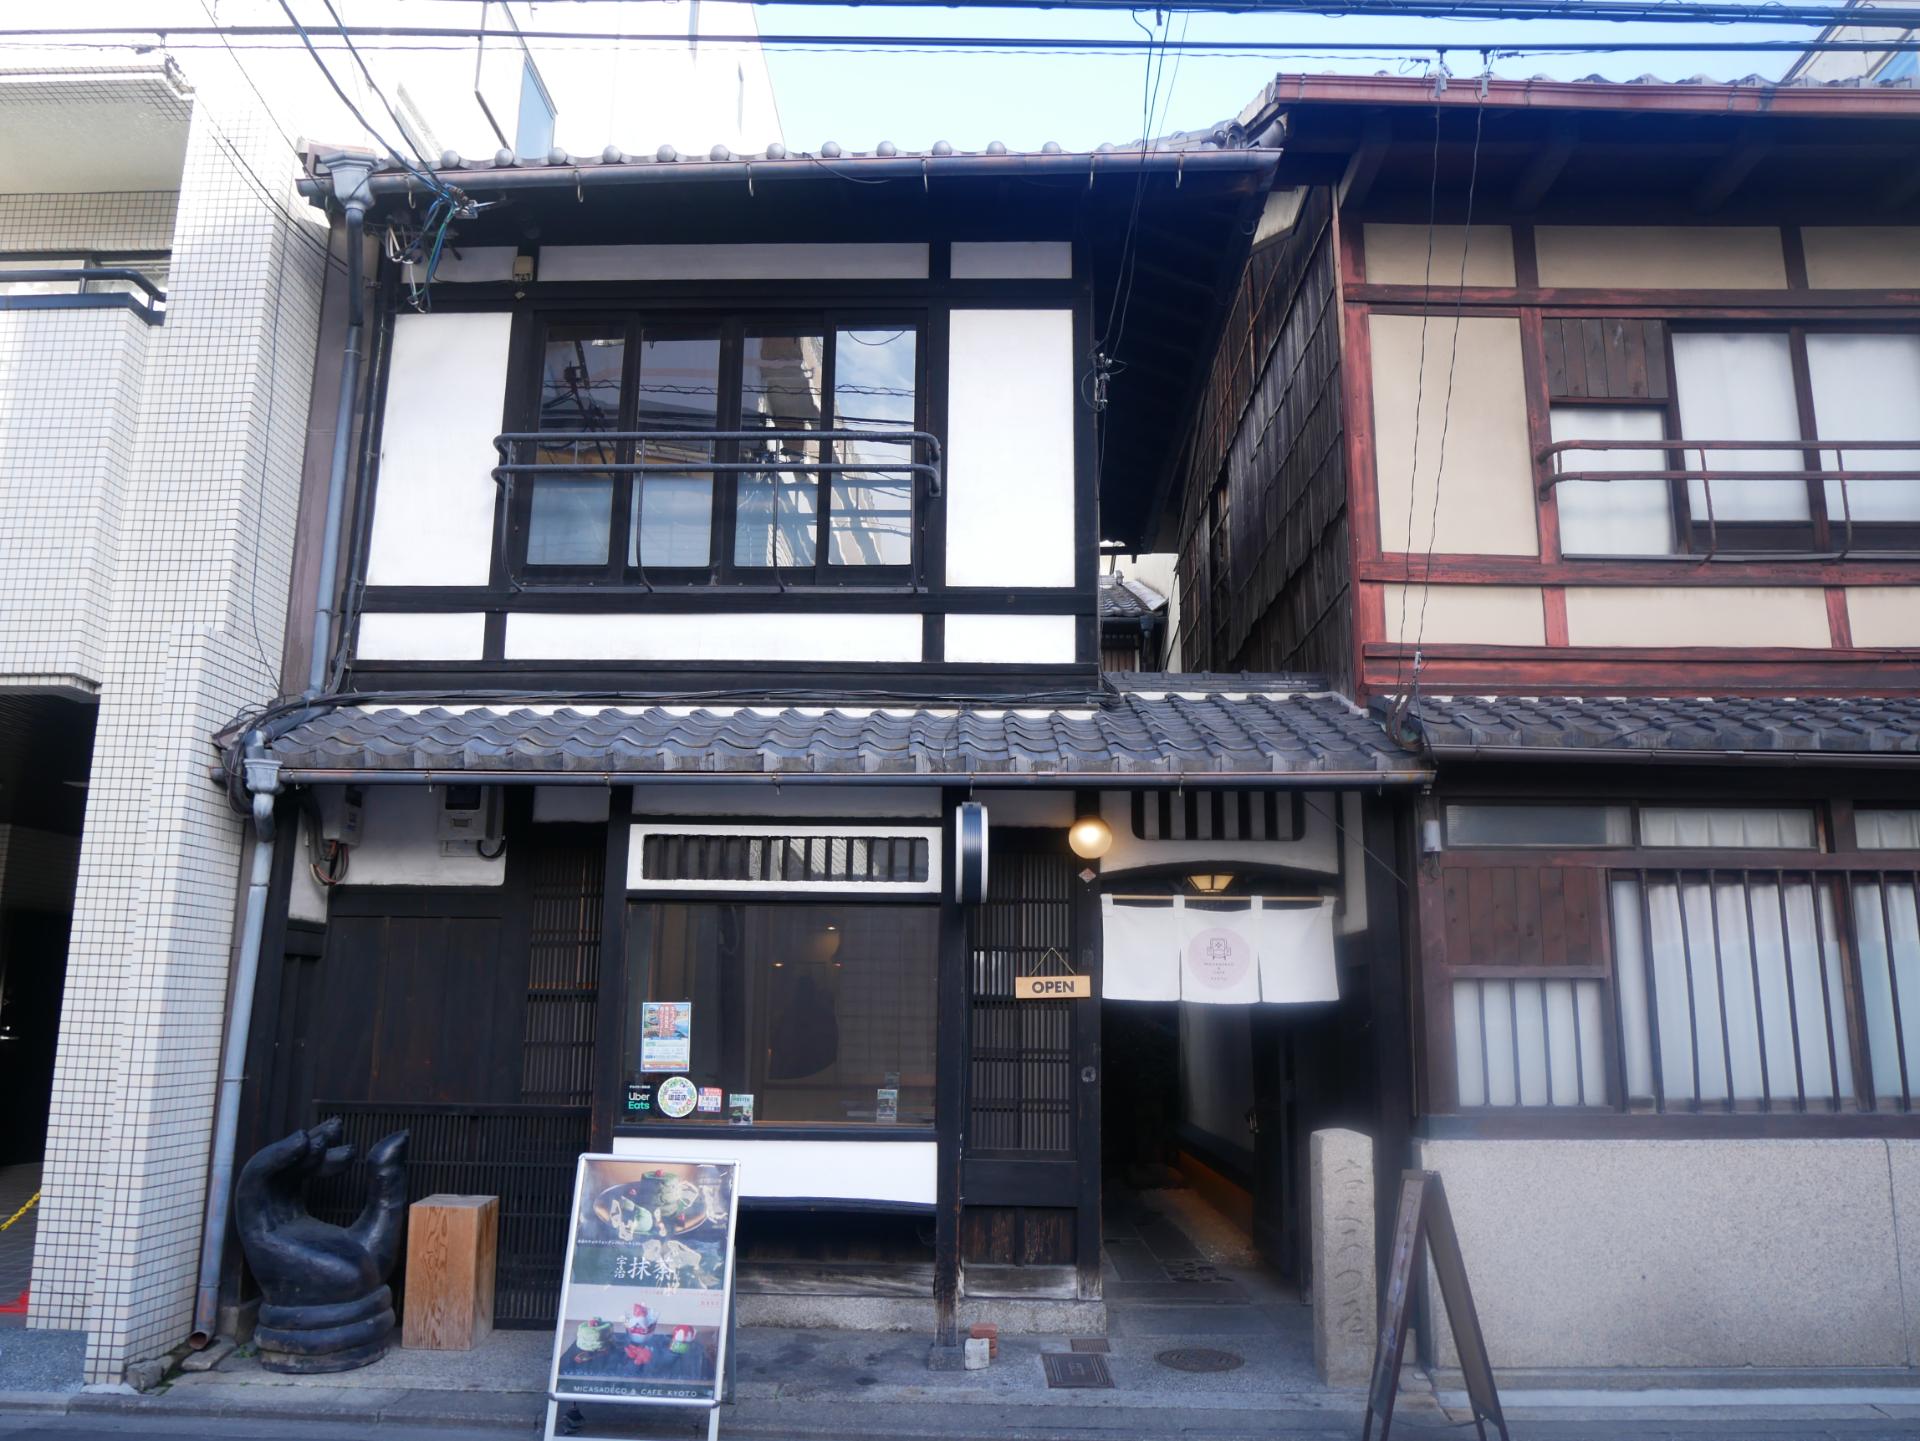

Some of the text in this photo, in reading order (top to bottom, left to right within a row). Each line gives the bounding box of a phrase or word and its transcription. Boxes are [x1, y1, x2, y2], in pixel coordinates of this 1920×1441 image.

[1031, 980, 1075, 994] OPEN
[628, 1092, 651, 1101] Uber
[628, 1101, 651, 1110] Eats
[614, 1255, 628, 1279] 宇治
[627, 1256, 675, 1281] 抹茶
[667, 1390, 698, 1398] KYOTO
